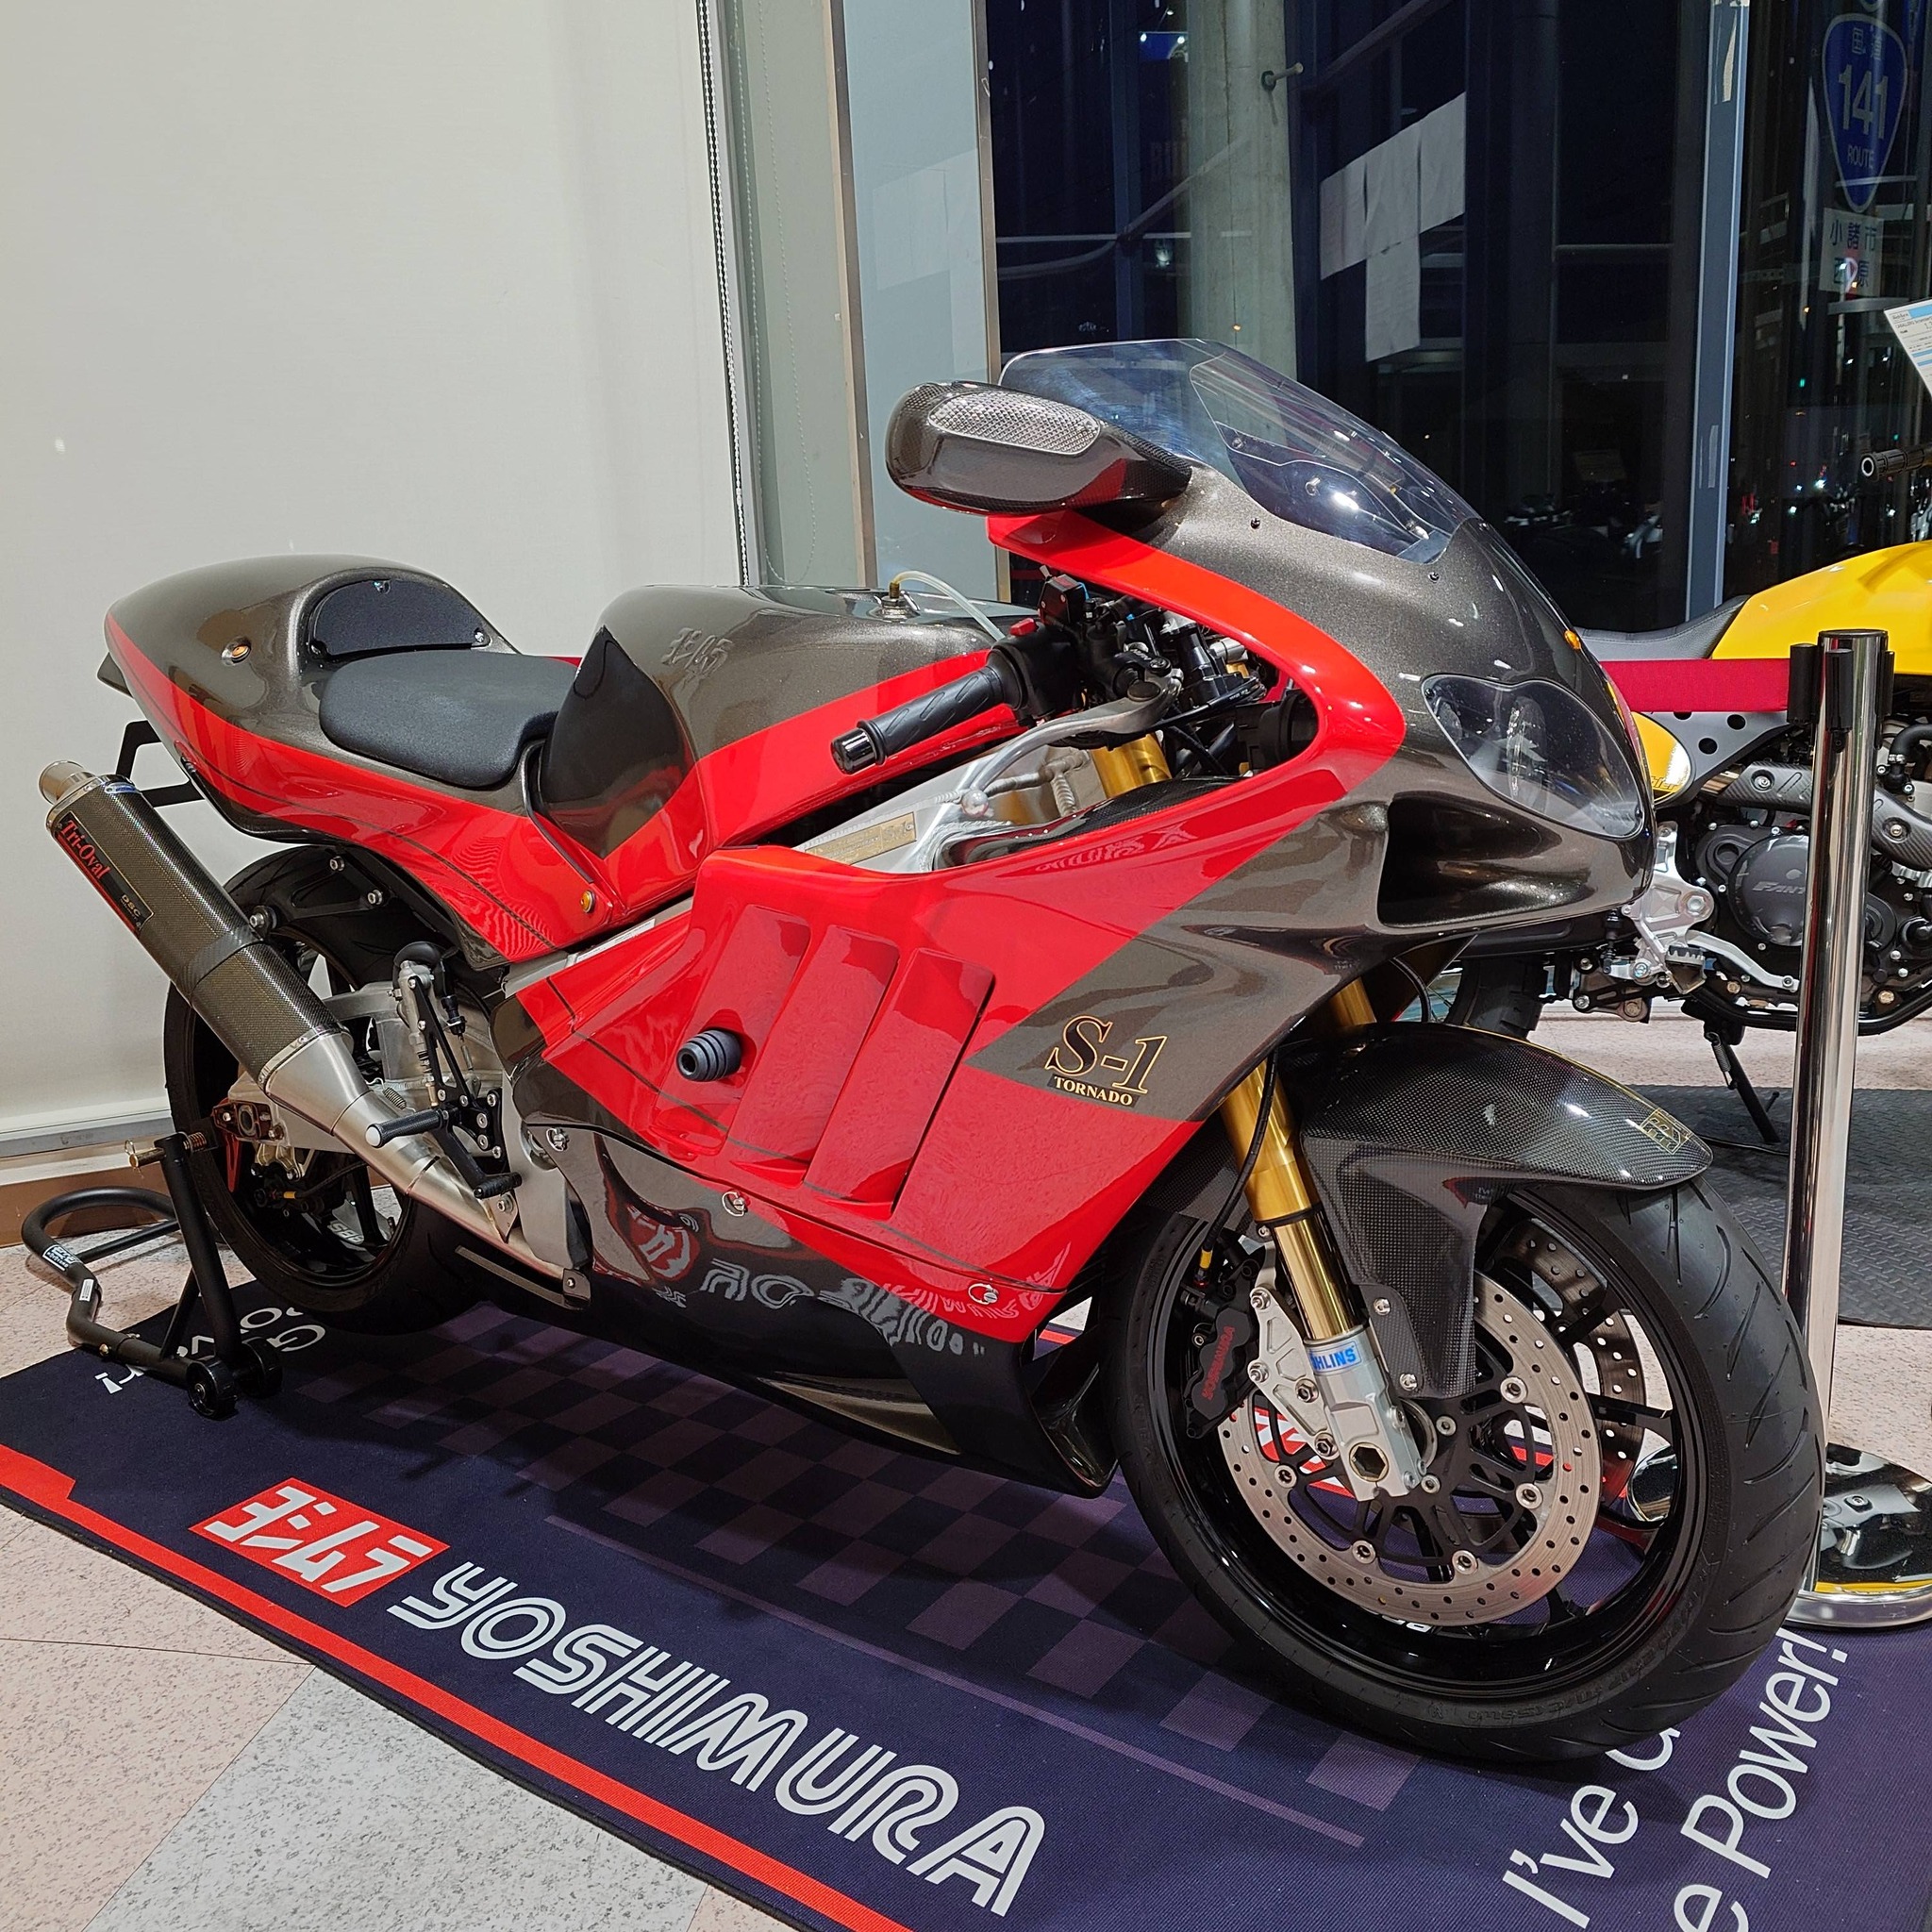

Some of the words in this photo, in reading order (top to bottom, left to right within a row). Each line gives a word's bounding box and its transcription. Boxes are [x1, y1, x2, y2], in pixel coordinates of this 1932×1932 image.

[1839, 63, 1889, 140] 141
[1846, 143, 1874, 169] ROUTE
[60, 819, 112, 880] Tri-Oval
[121, 893, 142, 917] DSC
[1752, 881, 1806, 894] FANT
[1044, 1015, 1168, 1094] S-1
[1054, 1075, 1133, 1106] TORNADO
[203, 1483, 432, 1594] ヨシムラ
[386, 1561, 1046, 1917] YOSHIMURA
[1680, 1628, 1849, 1879] Power!
